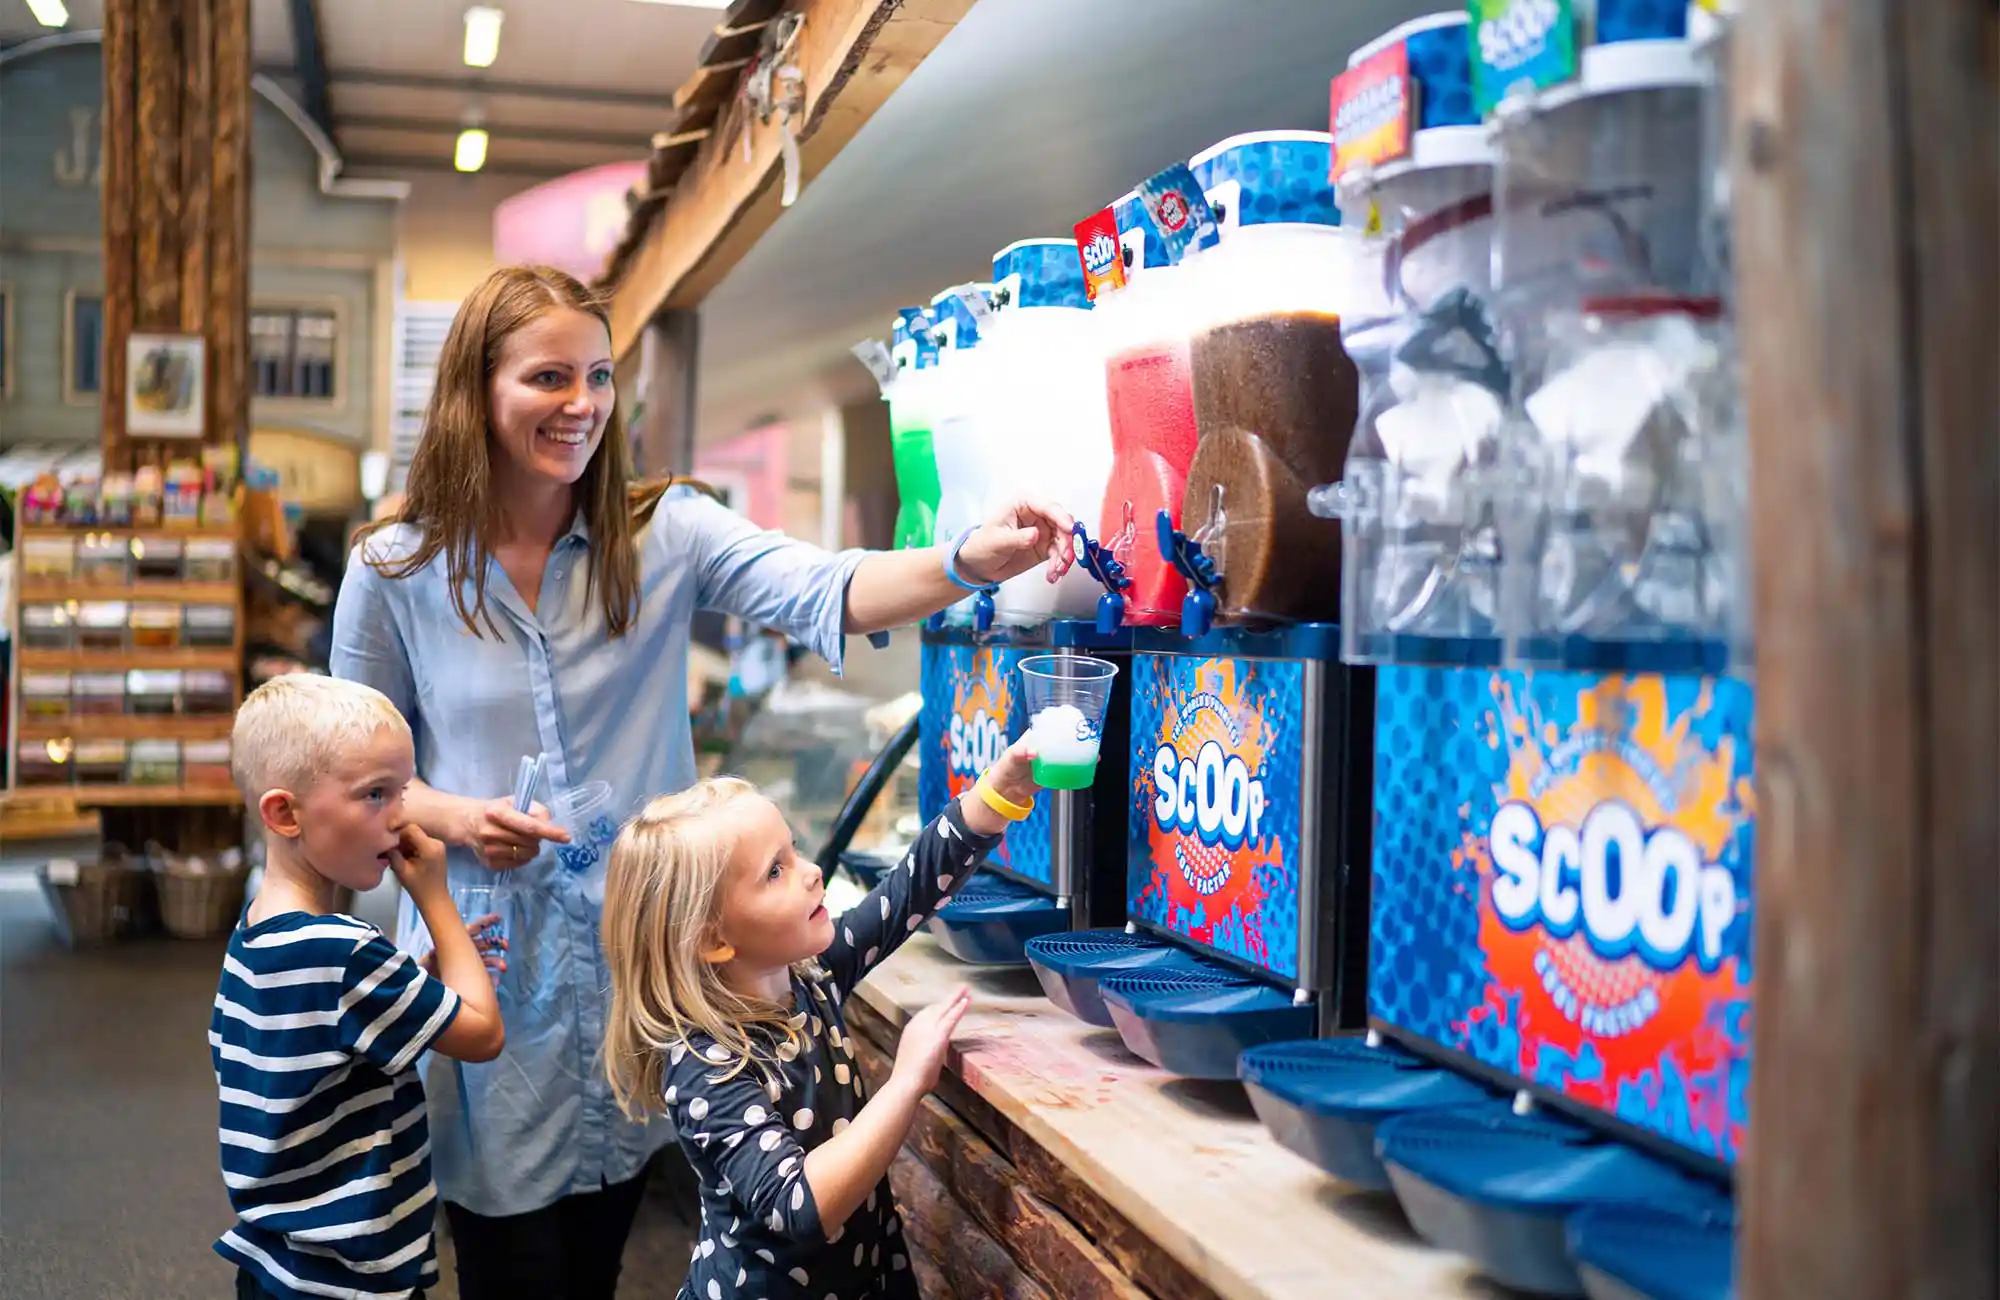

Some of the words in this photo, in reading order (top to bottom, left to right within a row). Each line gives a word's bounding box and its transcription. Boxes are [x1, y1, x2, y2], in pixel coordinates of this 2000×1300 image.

[1154, 741, 1264, 840] SCOOP
[1175, 842, 1195, 888] COOL
[1196, 860, 1231, 896] FACTOR
[1490, 801, 1735, 959] SCOOP
